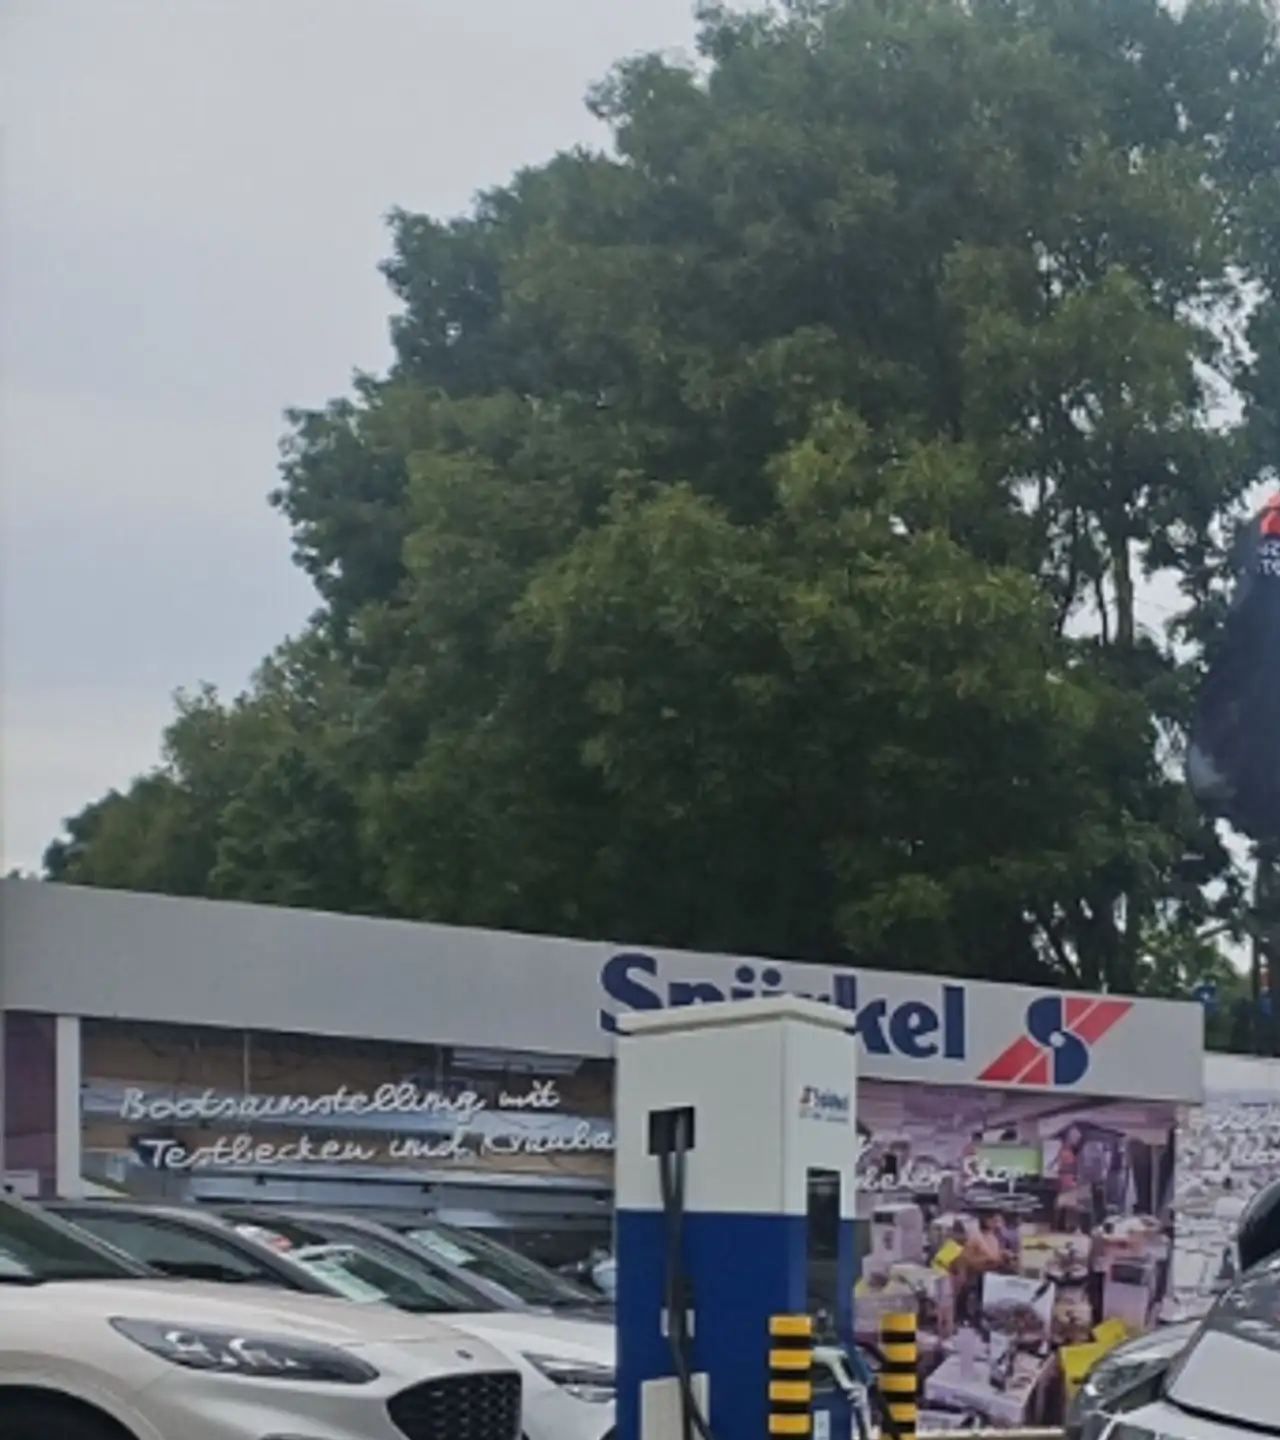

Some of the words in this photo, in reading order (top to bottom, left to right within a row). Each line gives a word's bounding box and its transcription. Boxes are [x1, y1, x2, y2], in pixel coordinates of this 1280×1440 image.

[600, 952, 966, 1060] Skel
[119, 1082, 488, 1126] Bootsausstellung
[499, 1080, 561, 1108] mit
[138, 1134, 376, 1169] Testbecken
